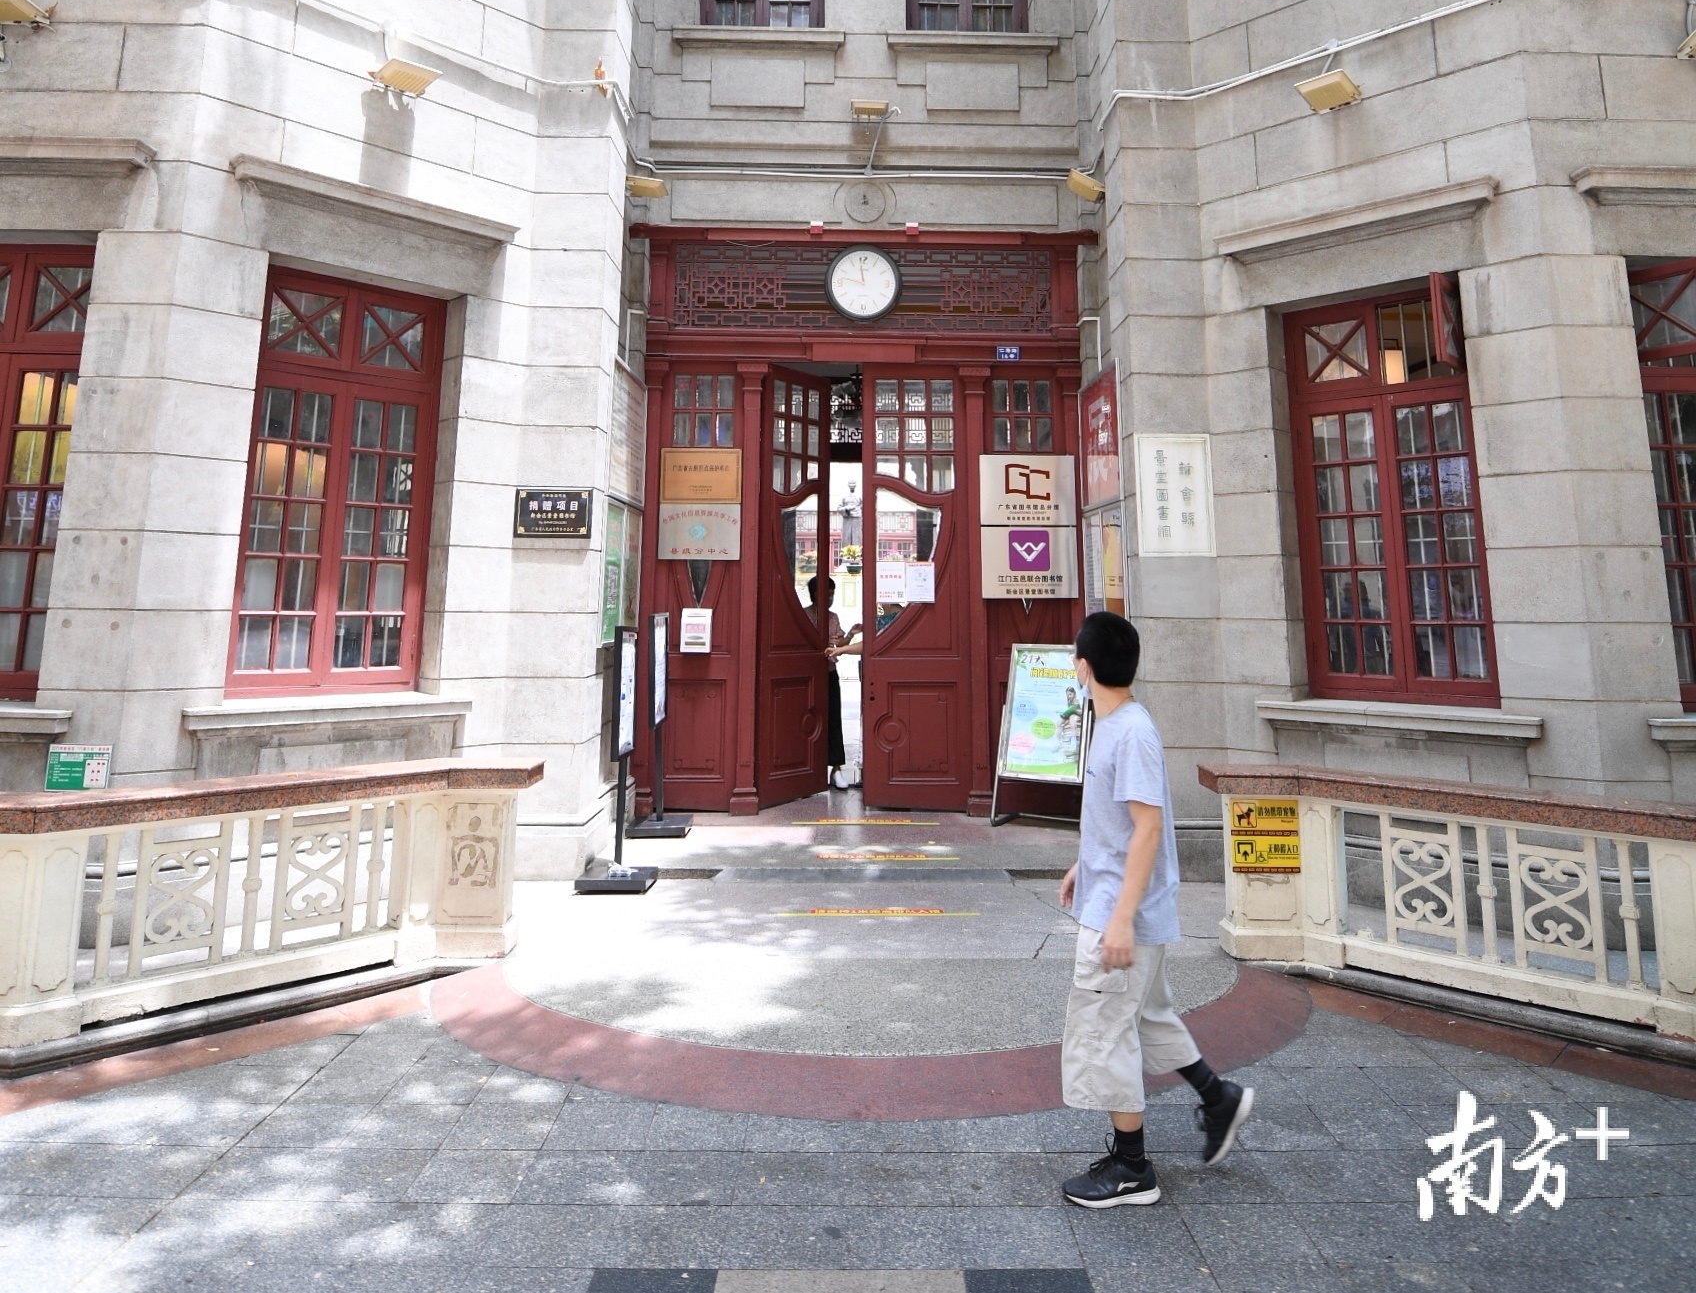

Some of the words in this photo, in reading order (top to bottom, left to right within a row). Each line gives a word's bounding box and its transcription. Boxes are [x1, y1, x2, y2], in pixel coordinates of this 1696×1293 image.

[1154, 449, 1171, 538] 景堂圖書館
[1178, 461, 1195, 526] 新會縣
[529, 500, 579, 511] 捐赠项目
[662, 510, 739, 525] 全国文化信息资源共享工程
[669, 547, 729, 555] 县级分中心
[998, 575, 1063, 583] 江门五邑联合图书馆
[1257, 806, 1296, 817] 请勿携带宠物
